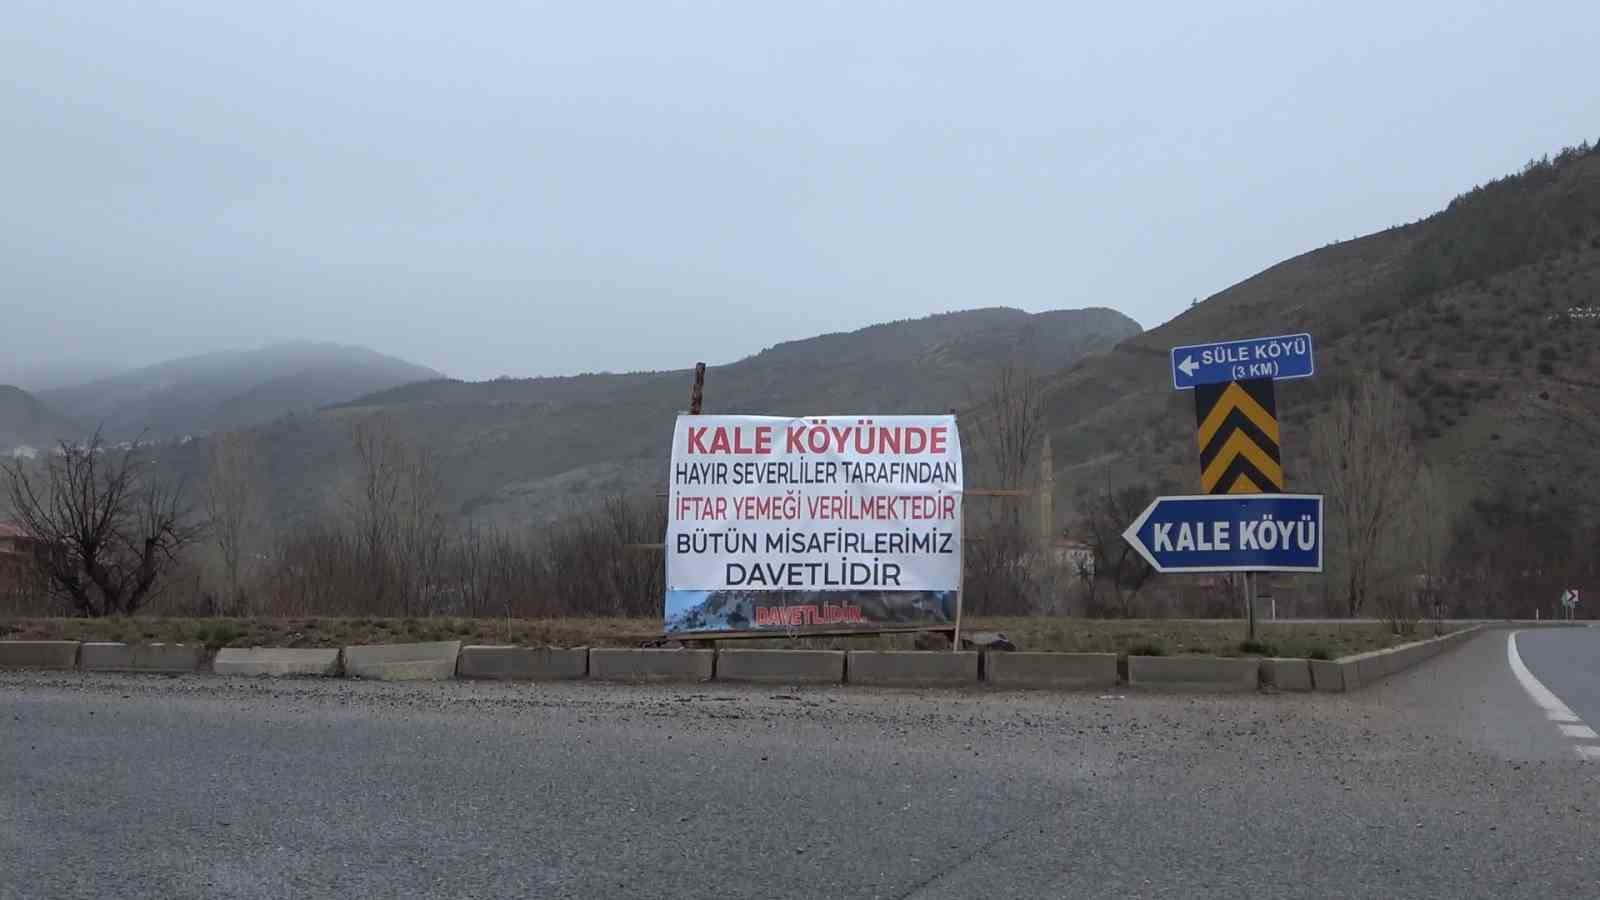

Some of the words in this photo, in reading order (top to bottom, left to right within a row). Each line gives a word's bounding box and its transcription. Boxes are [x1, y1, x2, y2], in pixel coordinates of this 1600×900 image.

[1202, 347, 1250, 365] SÜLE
[1255, 338, 1306, 359] KÖYÜ
[1232, 365, 1246, 380] (3
[1249, 360, 1279, 377] KM)
[687, 426, 772, 454] KALE
[786, 419, 947, 455] KÖYÜNDE
[676, 462, 728, 485] HAYIR
[732, 456, 837, 484] SEVERLİLER
[841, 461, 957, 484] TARAFINDAN
[676, 491, 727, 521] İFTAR
[733, 489, 801, 521] YEMEĞİ
[807, 490, 955, 520] VERİLMEKTEDİR
[677, 528, 757, 554] BÜTÜN
[766, 527, 953, 554] MİSAFİRLERİMİZ
[1153, 521, 1230, 551] KALE
[1239, 514, 1315, 551] KÖYÜ
[726, 556, 901, 586] DAVETLİDİR
